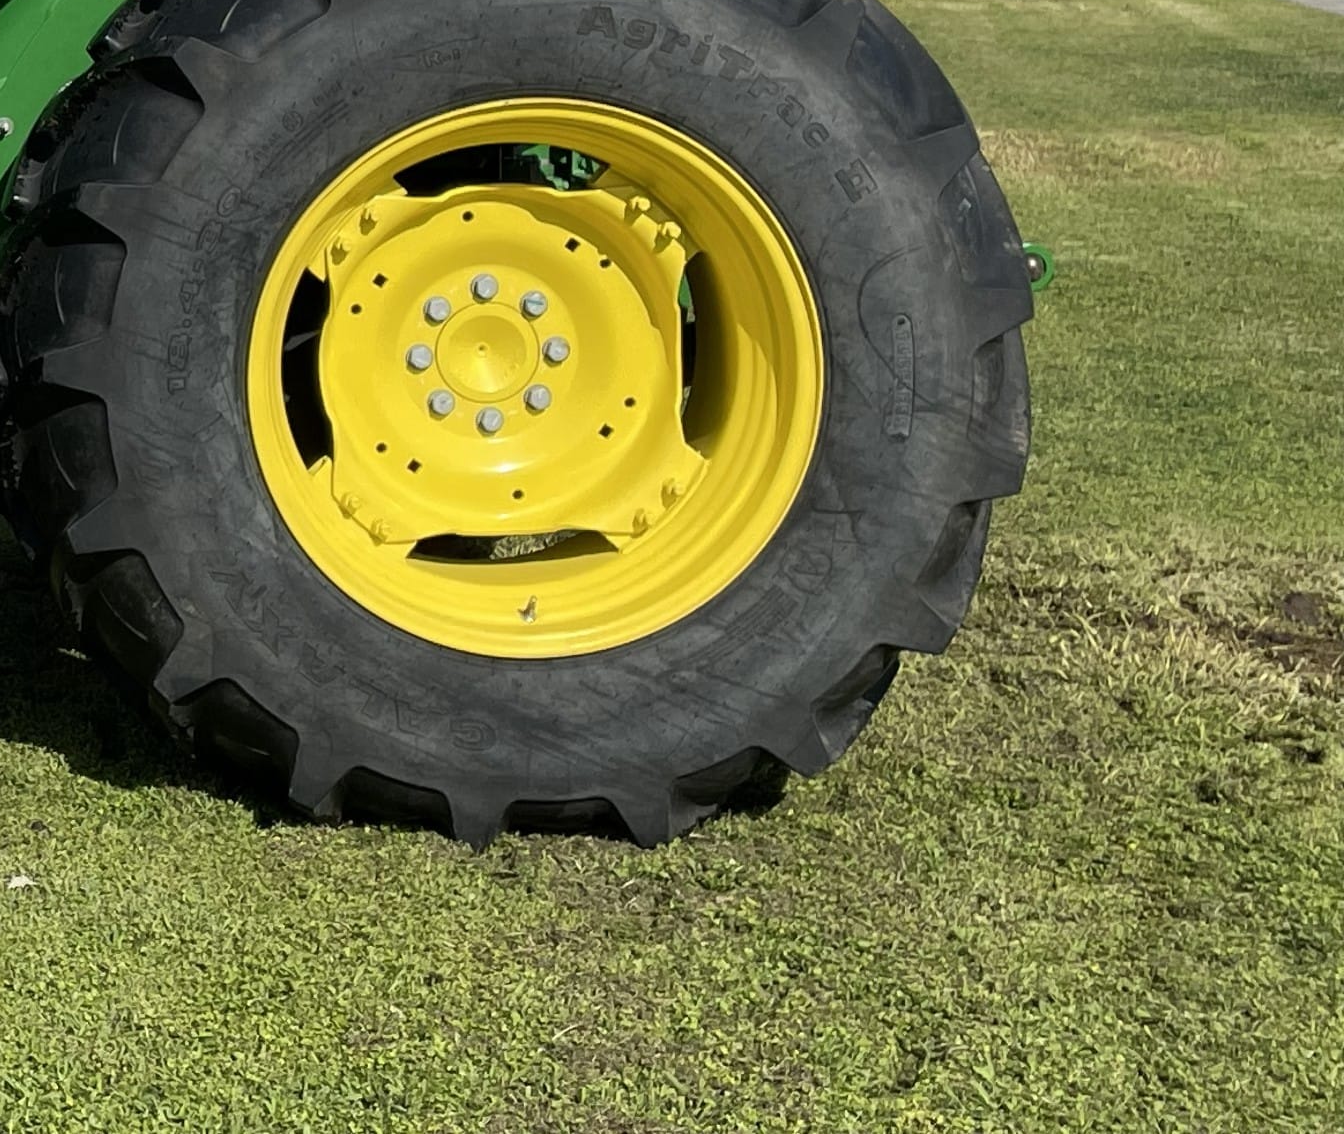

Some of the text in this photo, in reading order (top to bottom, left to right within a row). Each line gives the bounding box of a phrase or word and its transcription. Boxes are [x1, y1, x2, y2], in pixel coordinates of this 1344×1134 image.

[578, 4, 833, 152] AgriTrac
[169, 184, 242, 394] 18.4-30
[209, 564, 494, 752] GALAXY
